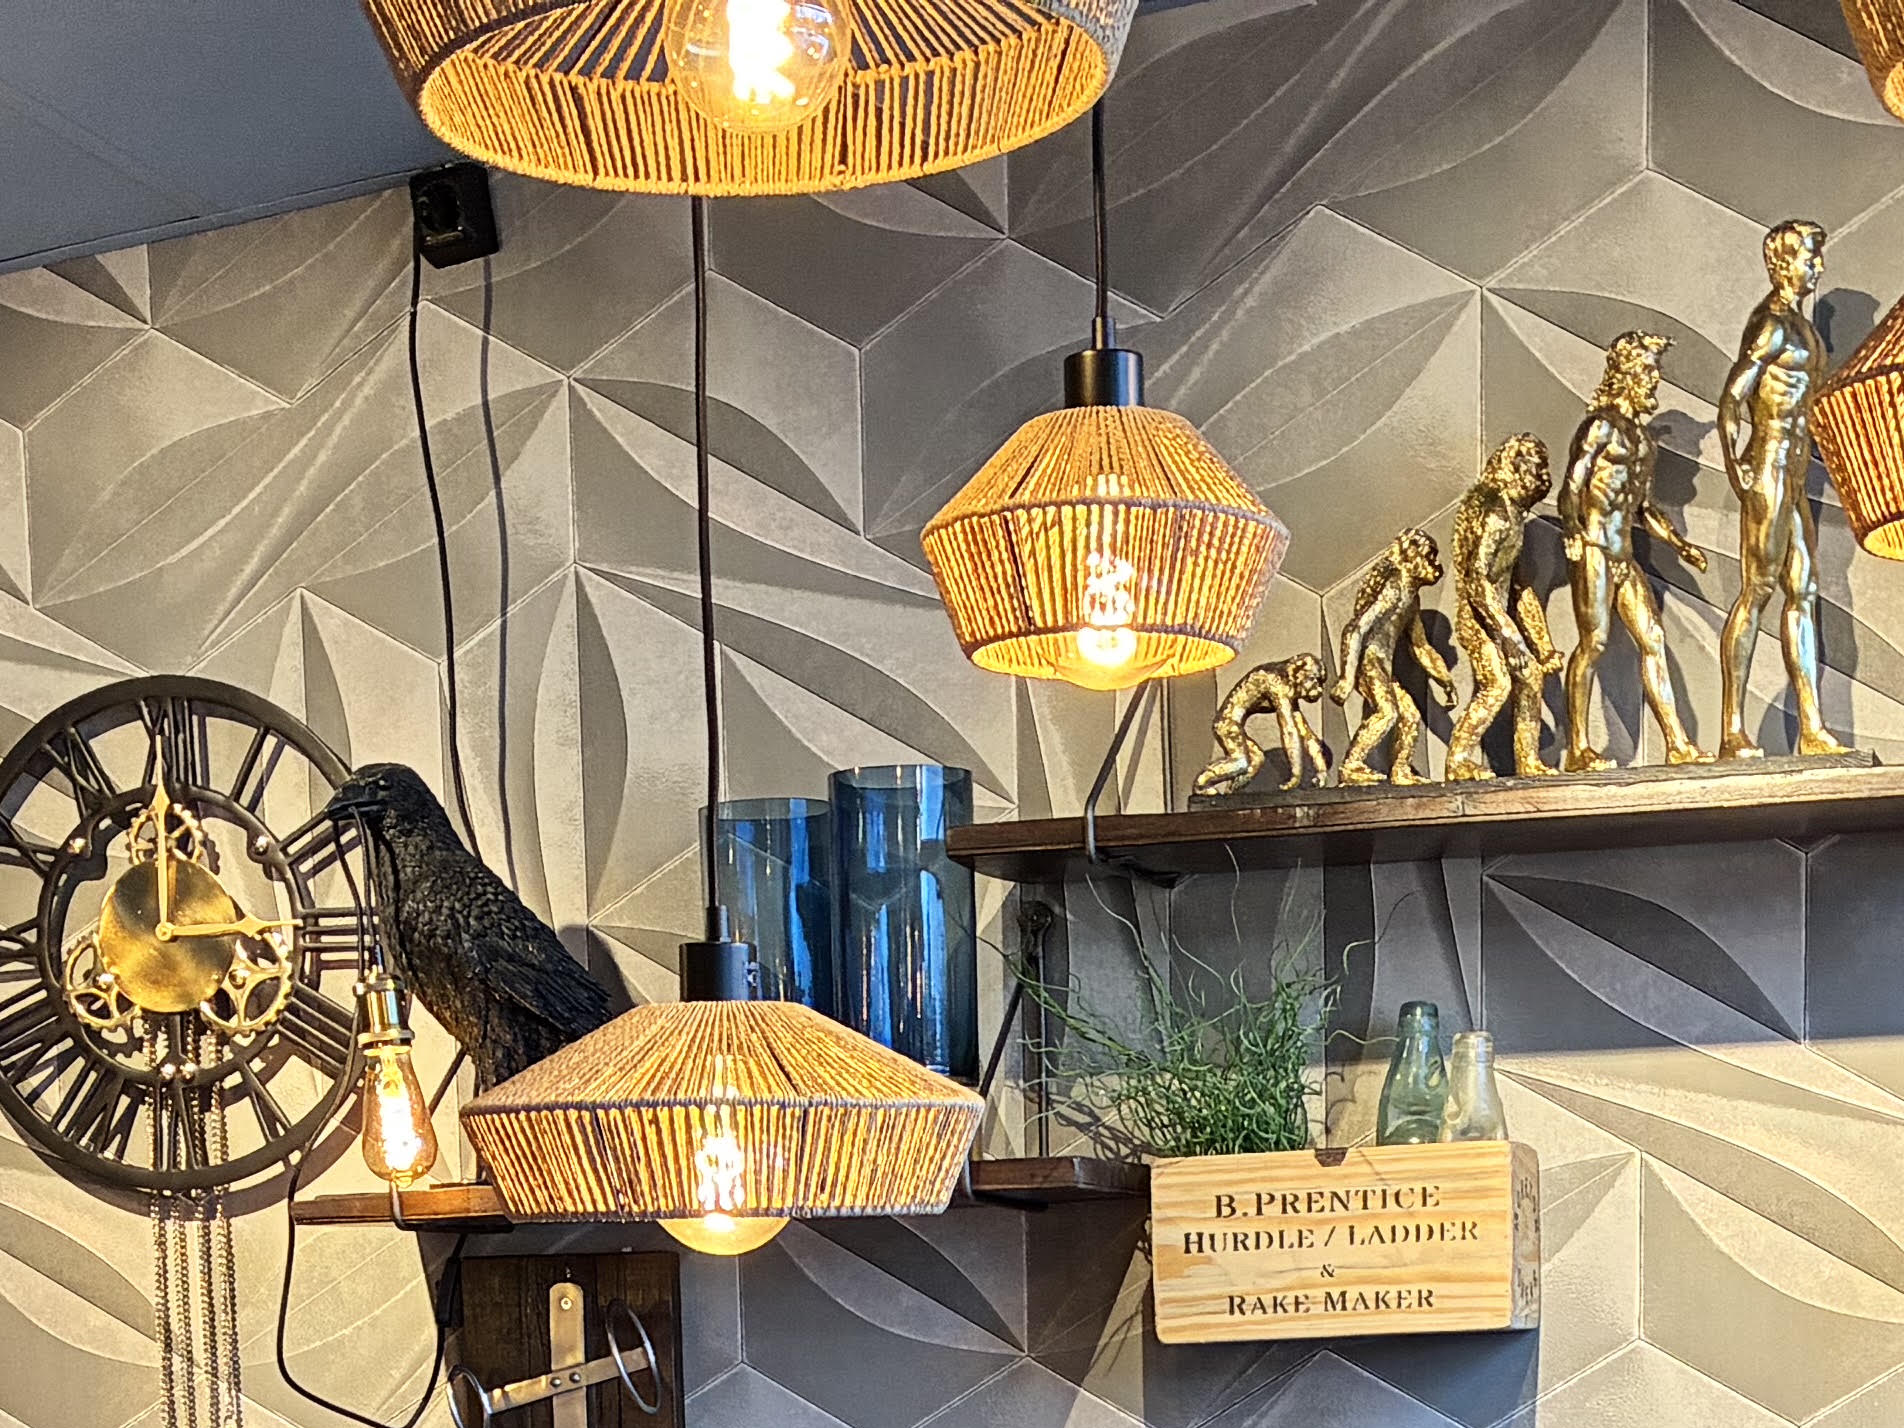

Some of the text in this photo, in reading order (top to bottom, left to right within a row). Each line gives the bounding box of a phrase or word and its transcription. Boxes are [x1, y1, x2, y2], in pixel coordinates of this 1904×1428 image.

[1183, 1227, 1316, 1255] HURDLE
[1348, 1220, 1480, 1247] LADDER
[1227, 1288, 1435, 1317] RAKE MAKER
